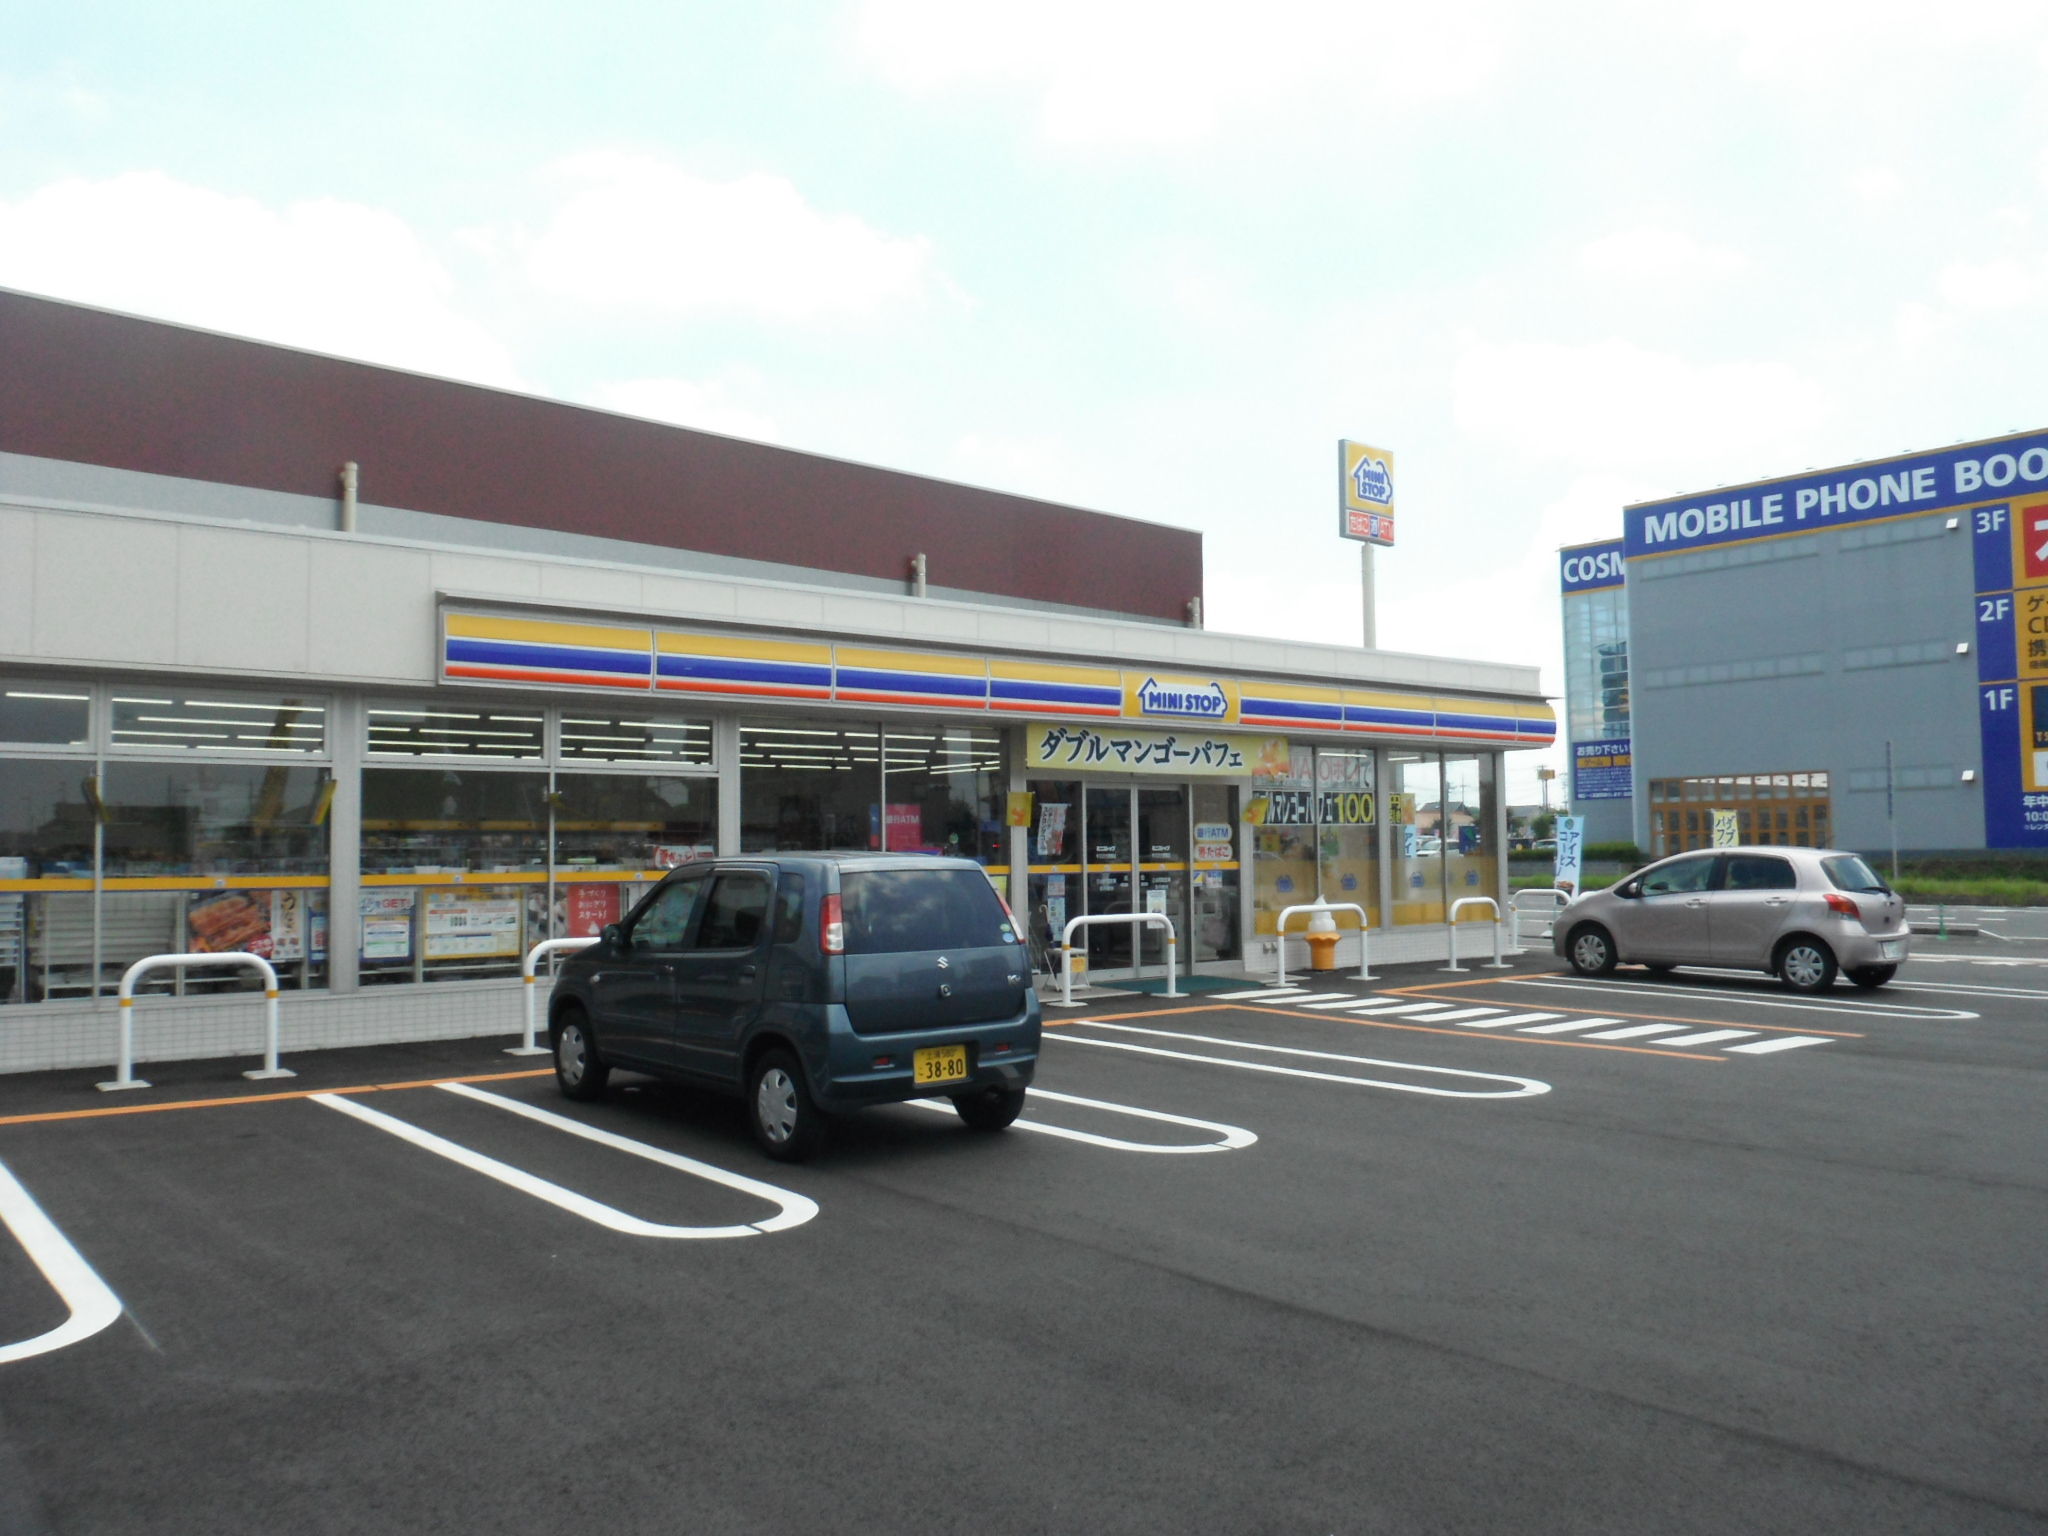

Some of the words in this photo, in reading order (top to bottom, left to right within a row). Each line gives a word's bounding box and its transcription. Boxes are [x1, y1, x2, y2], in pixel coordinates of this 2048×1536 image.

[1362, 468, 1385, 485] MINI
[1361, 482, 1386, 498] STOP
[1644, 493, 1784, 545] MOBILE
[1796, 466, 1937, 520] PHONE
[1954, 447, 2048, 494] BOO
[1976, 509, 2006, 533] 3F
[1980, 598, 2009, 622] 2F
[1149, 691, 1183, 709] MINI
[1185, 693, 1222, 712] STOP
[1984, 688, 2013, 711] 1F
[1041, 727, 1243, 768] ダブルマンゴーパフェ
[925, 1058, 964, 1079] 38-80
